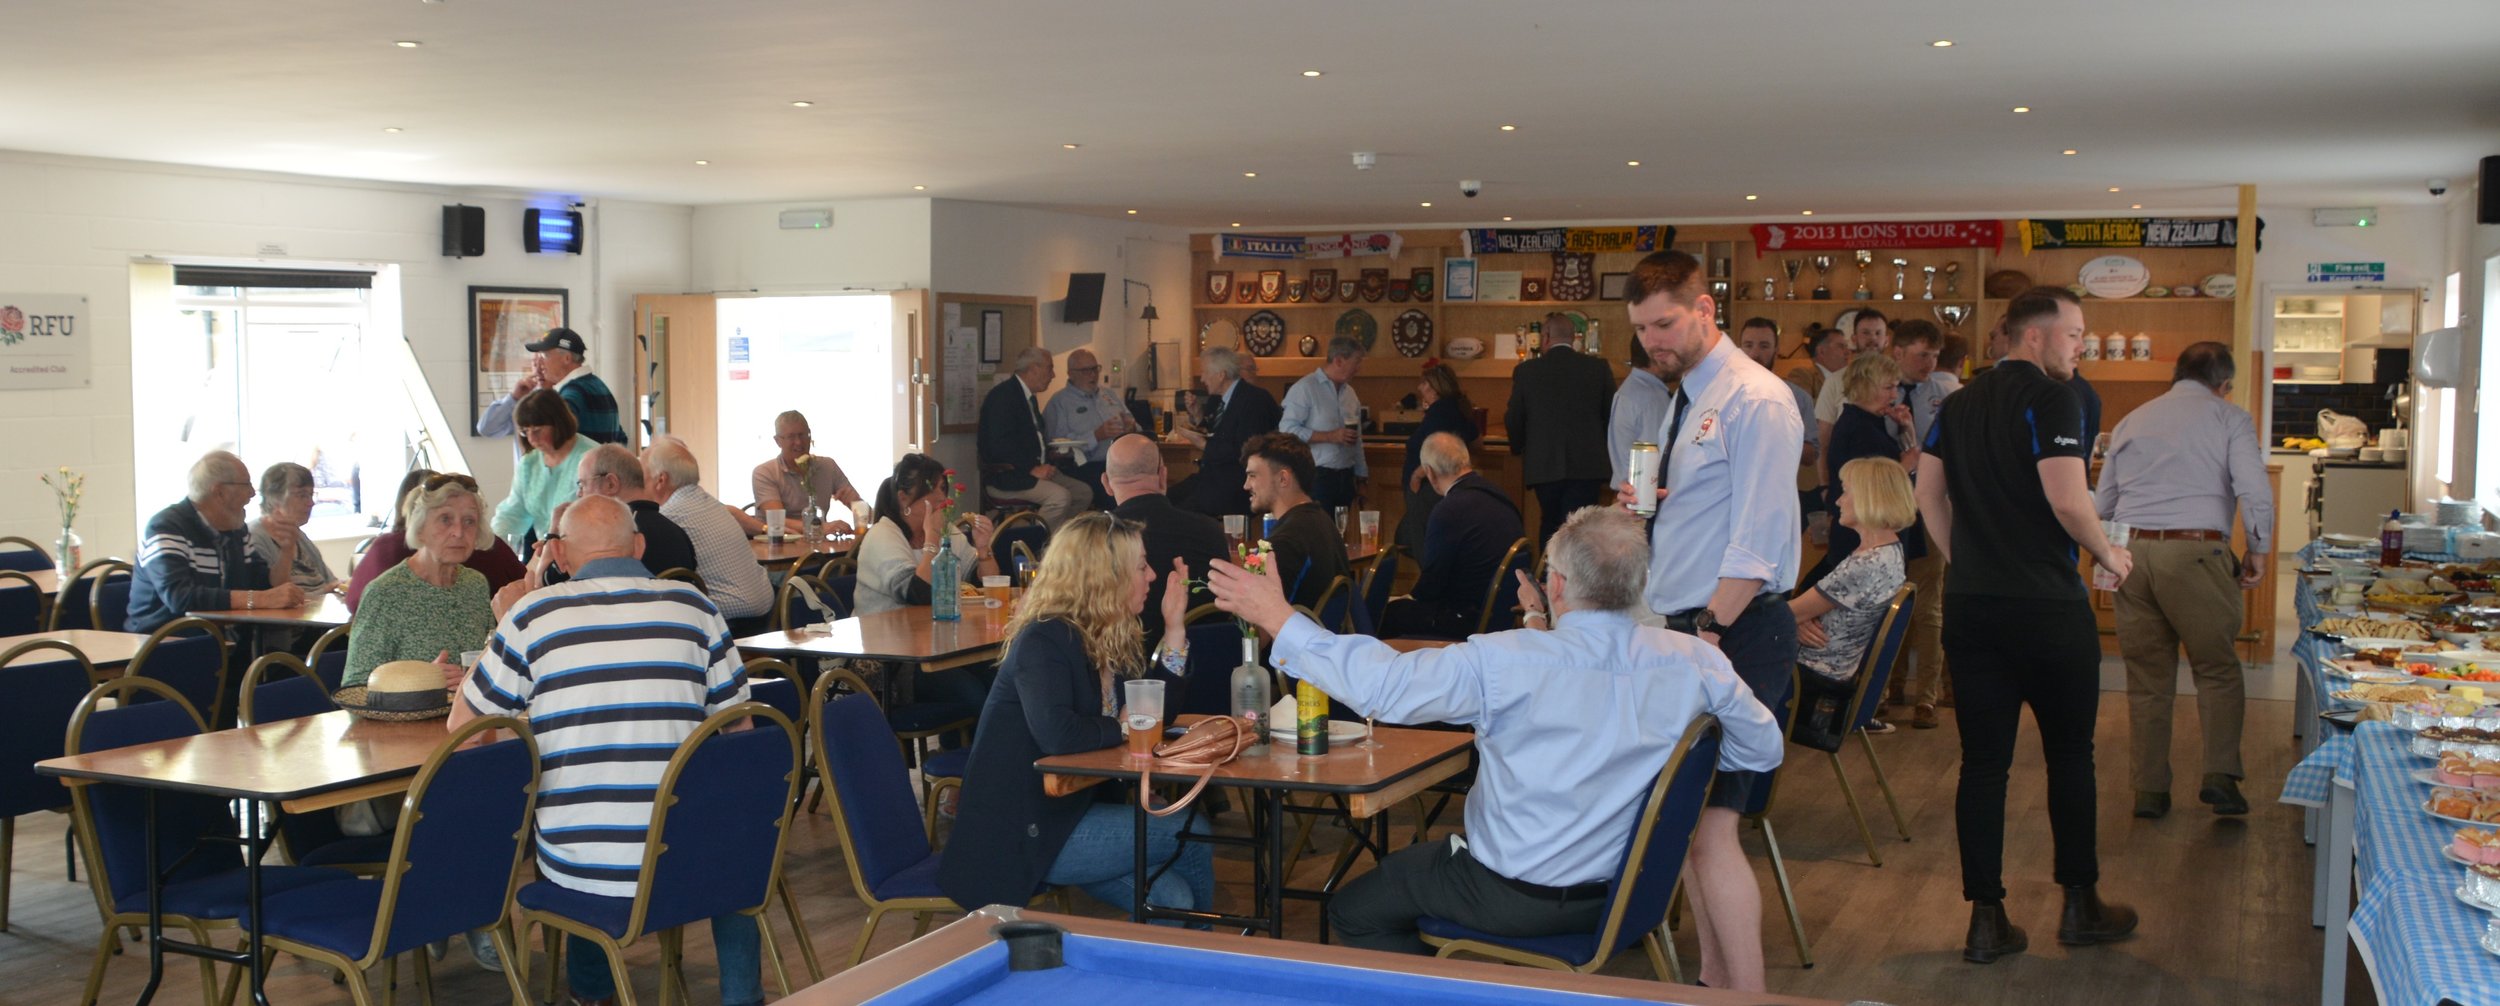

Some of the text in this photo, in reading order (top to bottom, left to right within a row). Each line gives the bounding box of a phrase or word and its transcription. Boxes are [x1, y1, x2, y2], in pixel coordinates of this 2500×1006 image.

[1793, 224, 1957, 240] 2013 LIONS TOUR
[2065, 223, 2100, 241] SOUTH
[2102, 223, 2141, 241] AFRICA
[2146, 223, 2220, 242] NEW ZEALAND
[1311, 239, 1369, 252] ENGLAND
[1498, 234, 1561, 249] NEW ZEALAND
[1572, 231, 1633, 248] AUSTRALIA
[1844, 239, 1906, 248] AUSTRALIA
[1247, 241, 1297, 253] ITALIA
[2335, 263, 2370, 273] Fire exit
[28, 314, 75, 337] RFU
[10, 365, 67, 374] Accredited Club
[2054, 435, 2078, 446] dyson
